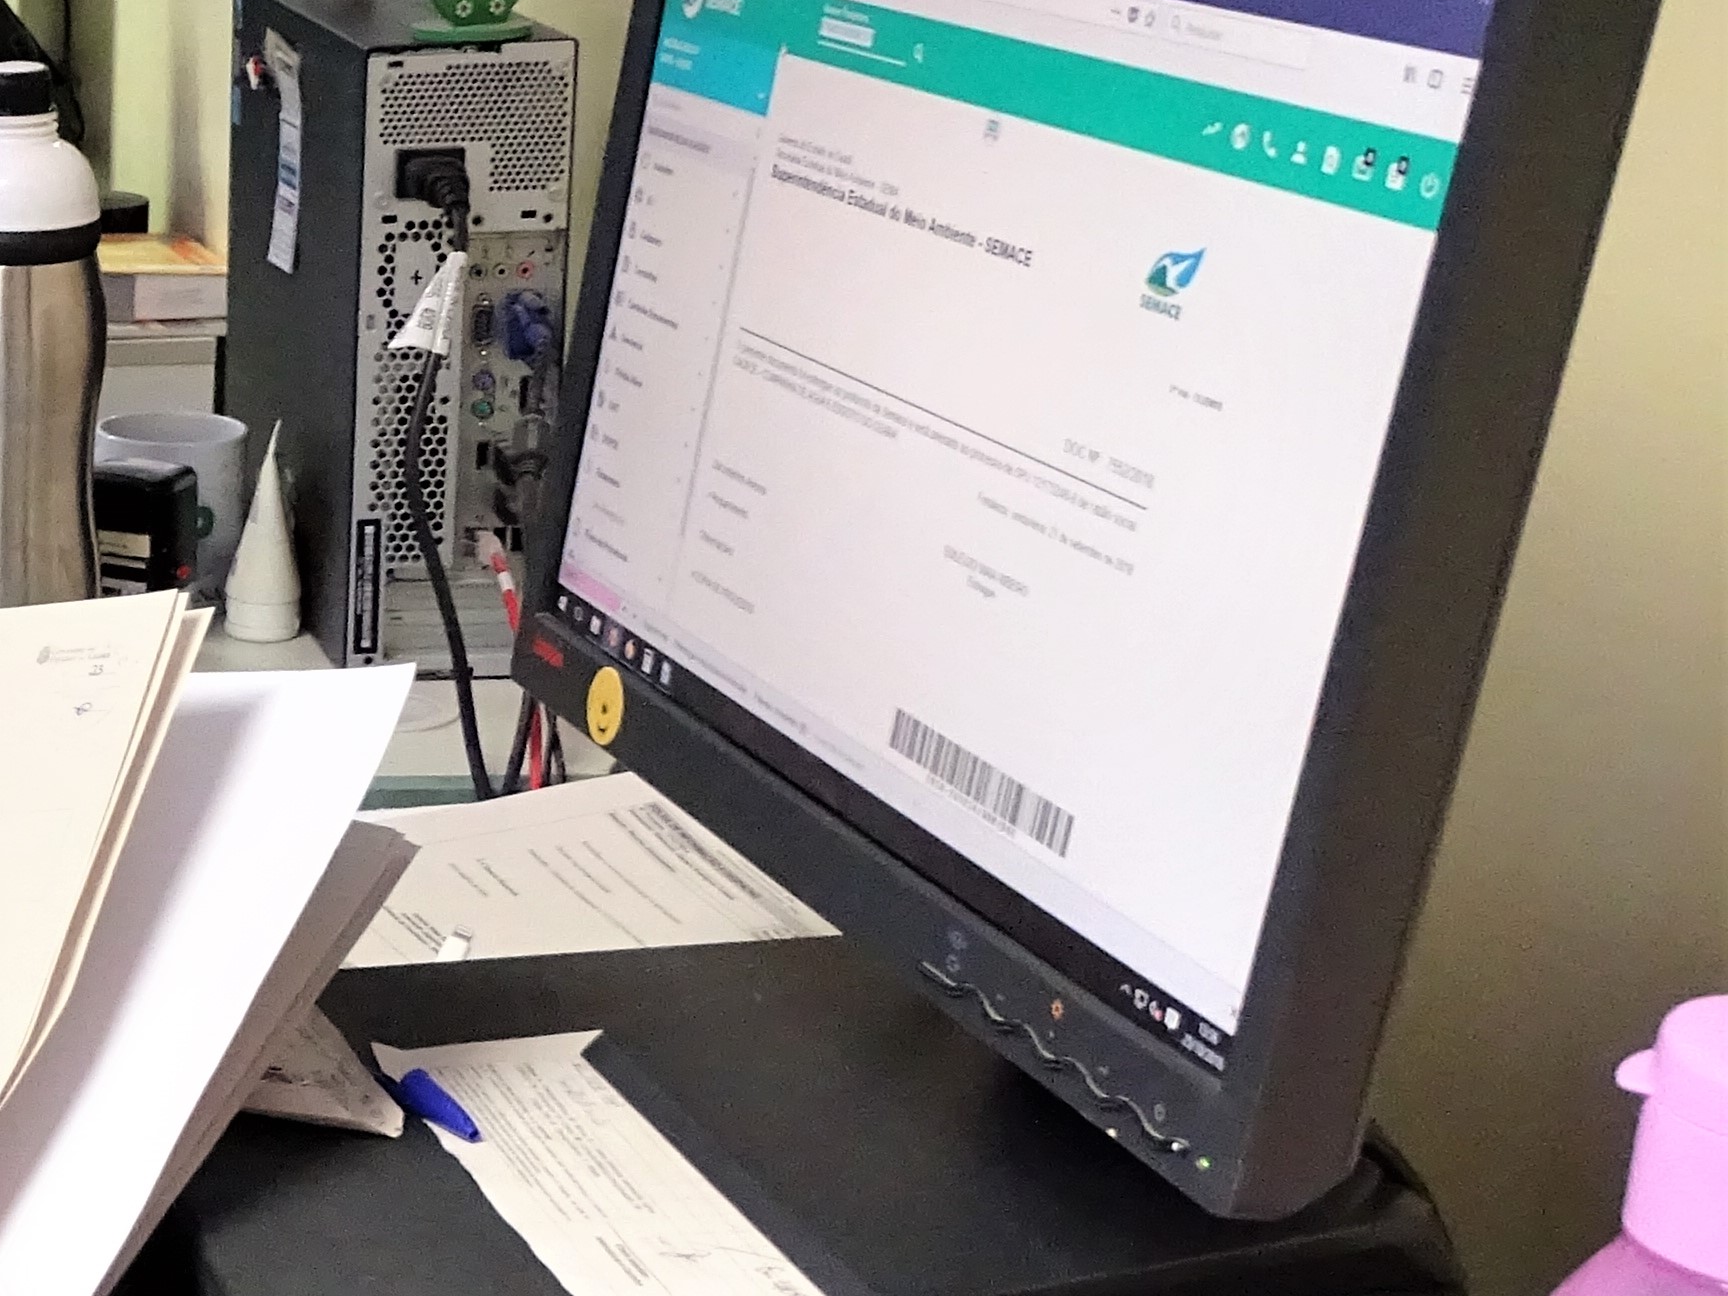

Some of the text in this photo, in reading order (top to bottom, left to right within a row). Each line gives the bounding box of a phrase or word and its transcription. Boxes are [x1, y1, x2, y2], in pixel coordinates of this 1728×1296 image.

[847, 189, 886, 216] Estadual
[890, 205, 900, 221] do
[904, 207, 926, 230] Meio
[928, 218, 976, 248] Ambiente
[984, 236, 1033, 268] SEMACE
[1140, 293, 1182, 321] SEMACE
